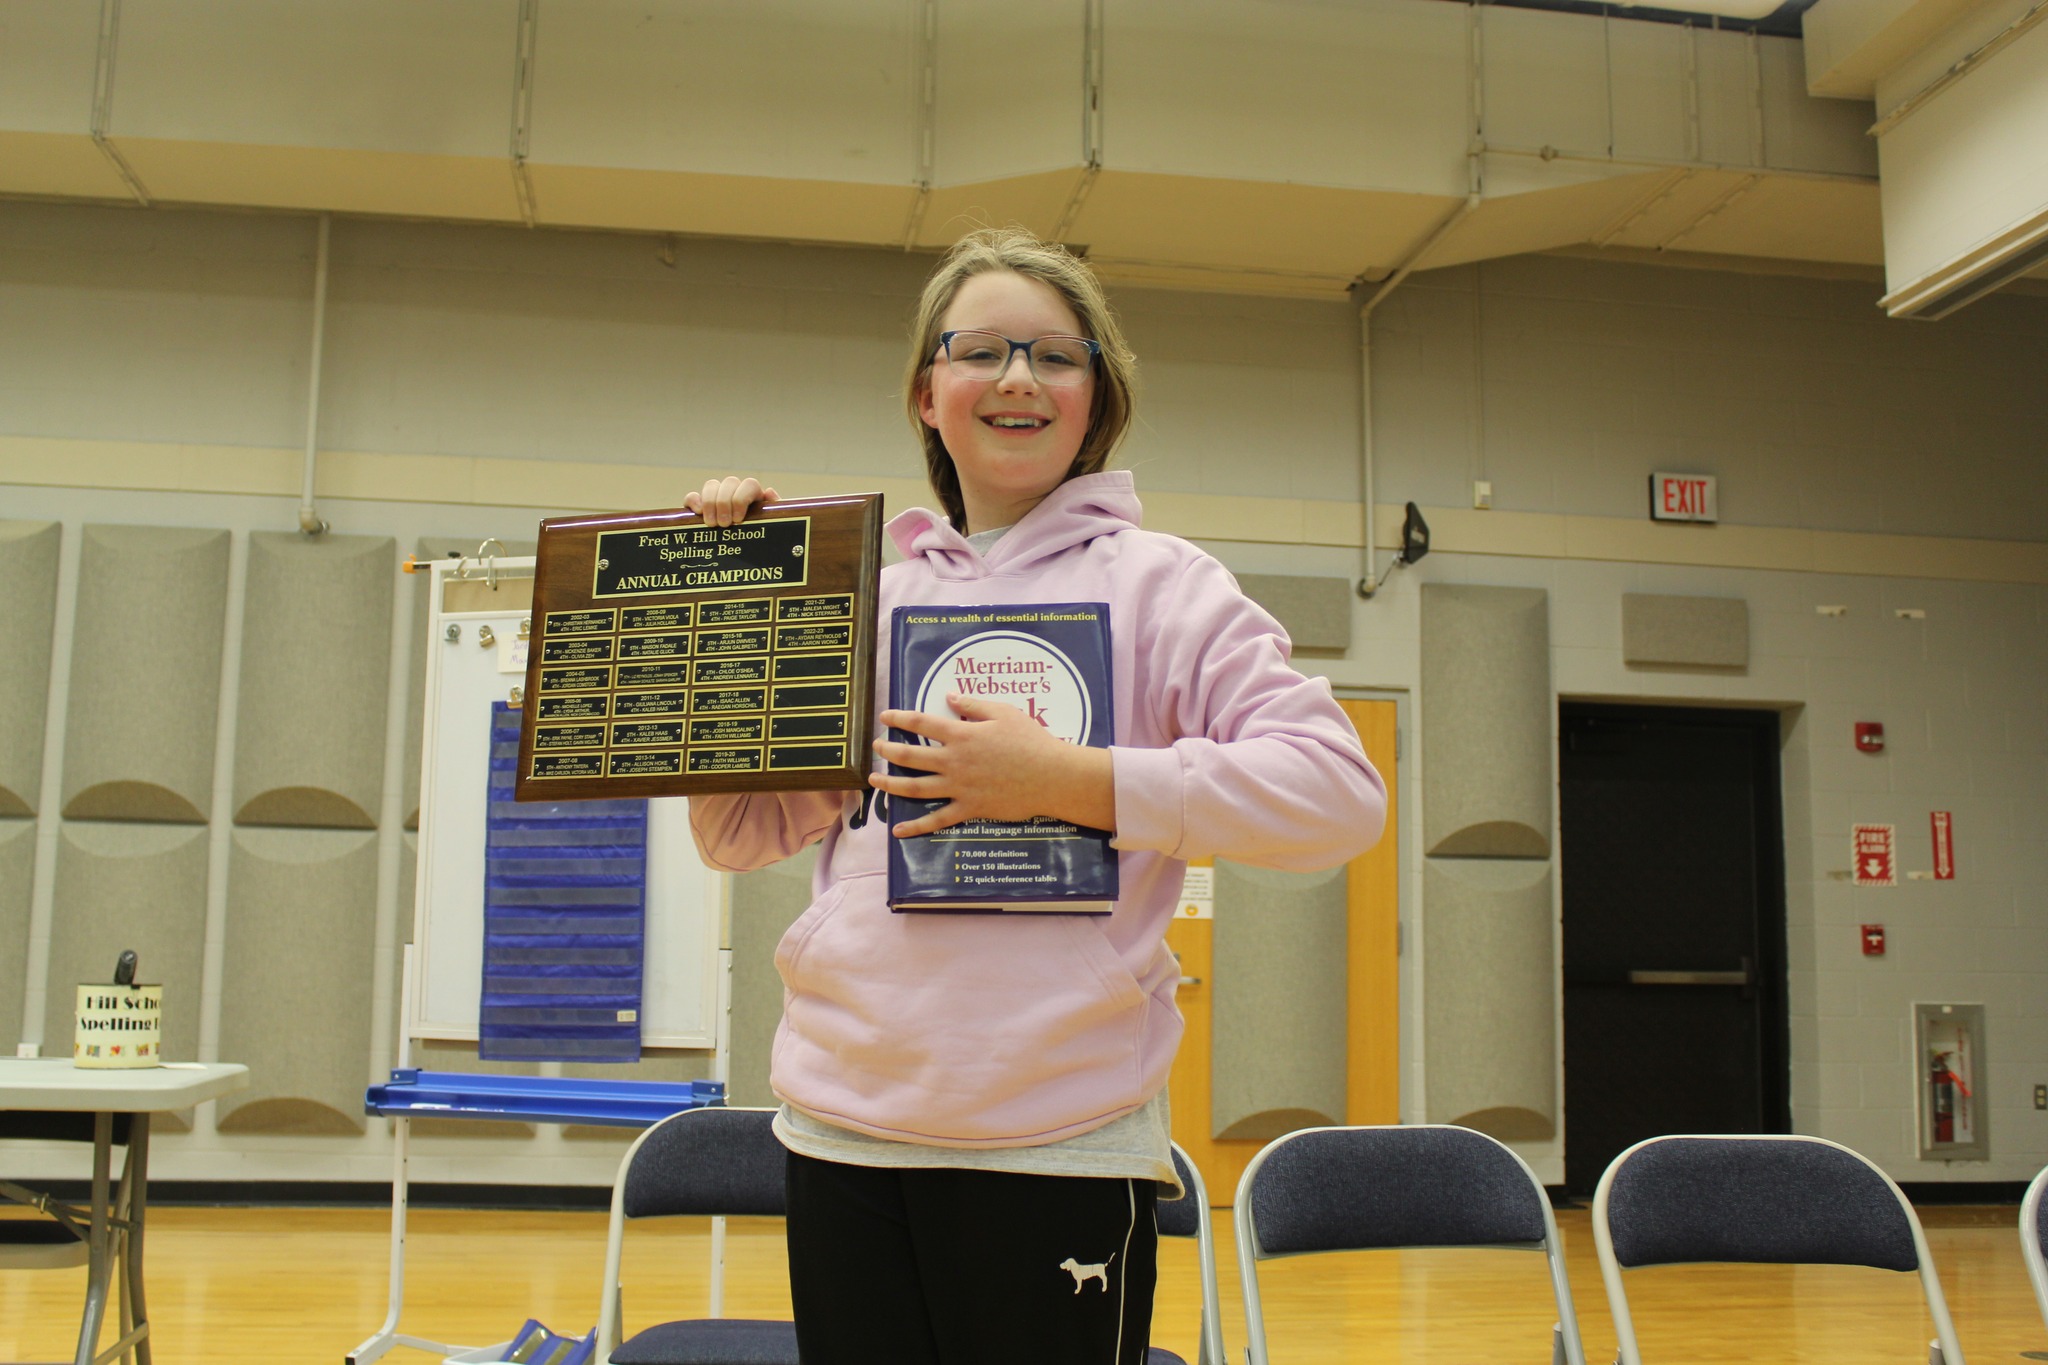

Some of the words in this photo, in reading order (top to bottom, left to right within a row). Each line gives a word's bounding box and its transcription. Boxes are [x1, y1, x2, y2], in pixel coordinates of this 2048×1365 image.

[1664, 478, 1707, 514] EXIT
[639, 535, 669, 547] Fred
[674, 534, 688, 544] W.
[693, 531, 717, 543] Hill
[722, 527, 765, 541] School
[660, 547, 713, 561] Spelling
[717, 544, 742, 556] Bee
[616, 574, 681, 590] ANNUAL
[686, 567, 783, 585] CHAMPIONS
[949, 614, 981, 623] wealth
[984, 614, 994, 622] of
[996, 613, 1038, 622] essential
[1041, 612, 1097, 621] information
[954, 656, 1053, 674] Merriam-
[955, 676, 1051, 694] Webster's
[982, 826, 1022, 836] language
[1859, 832, 1885, 843] FIRE
[975, 876, 1033, 884] quick-reference
[87, 996, 117, 1009] Hill
[81, 1018, 151, 1030] Spelling
